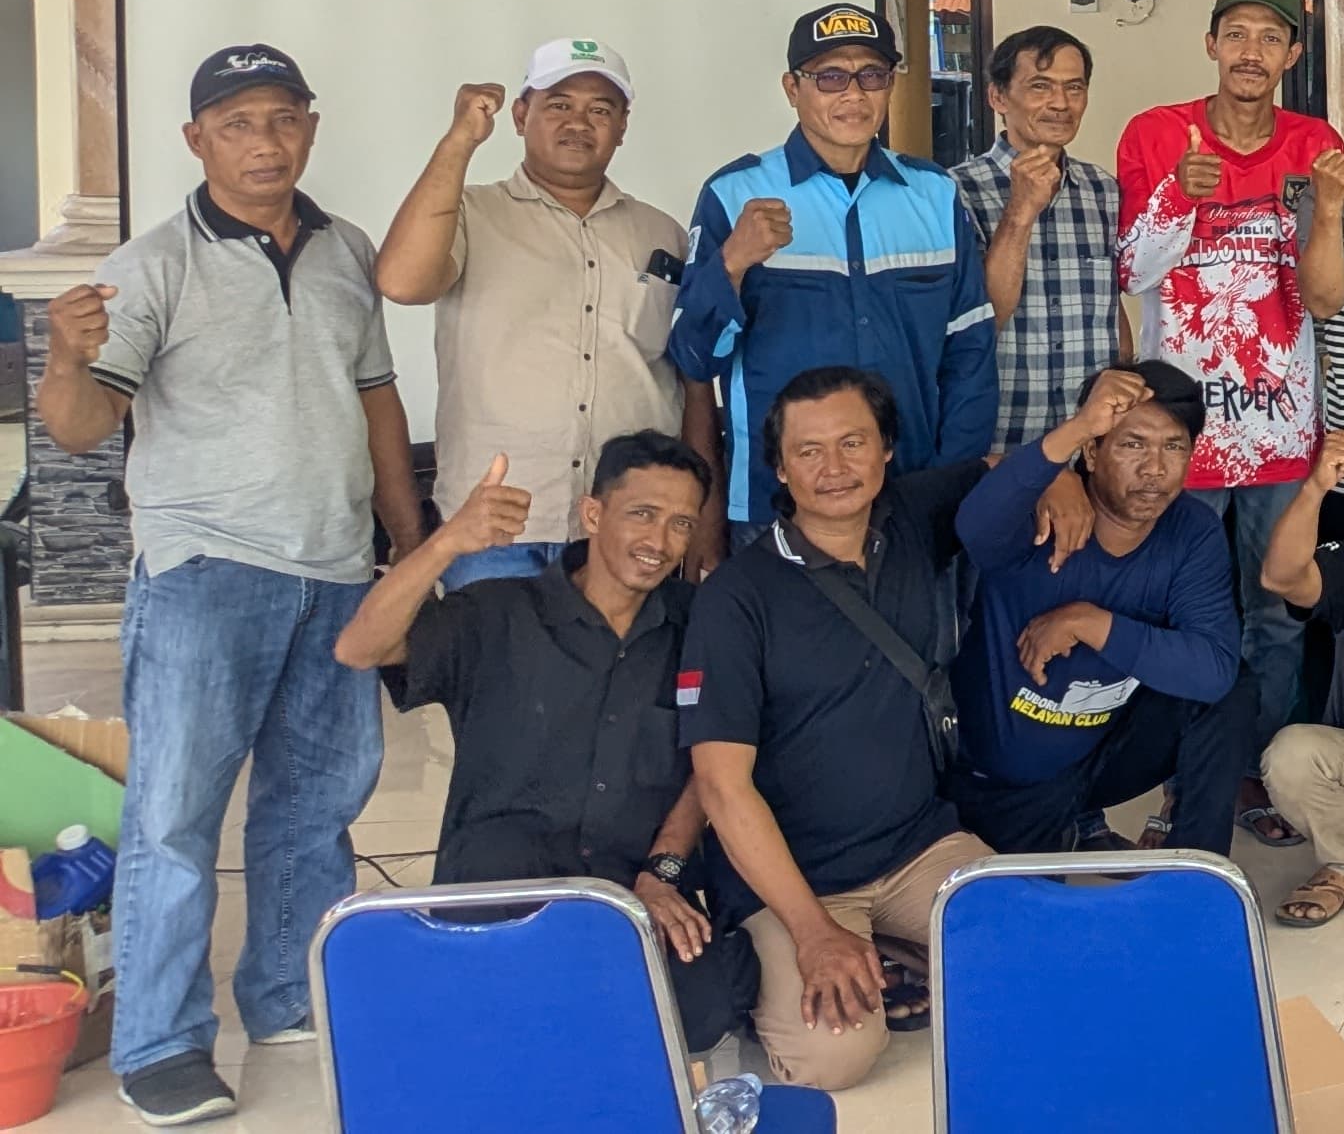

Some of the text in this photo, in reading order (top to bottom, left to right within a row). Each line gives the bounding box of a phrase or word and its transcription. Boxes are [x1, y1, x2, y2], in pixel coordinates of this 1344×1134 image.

[819, 15, 872, 35] VANS
[1212, 225, 1274, 235] REPUBLIK
[1202, 376, 1298, 422] ERDEKA
[1010, 696, 1074, 726] NELAYAN
